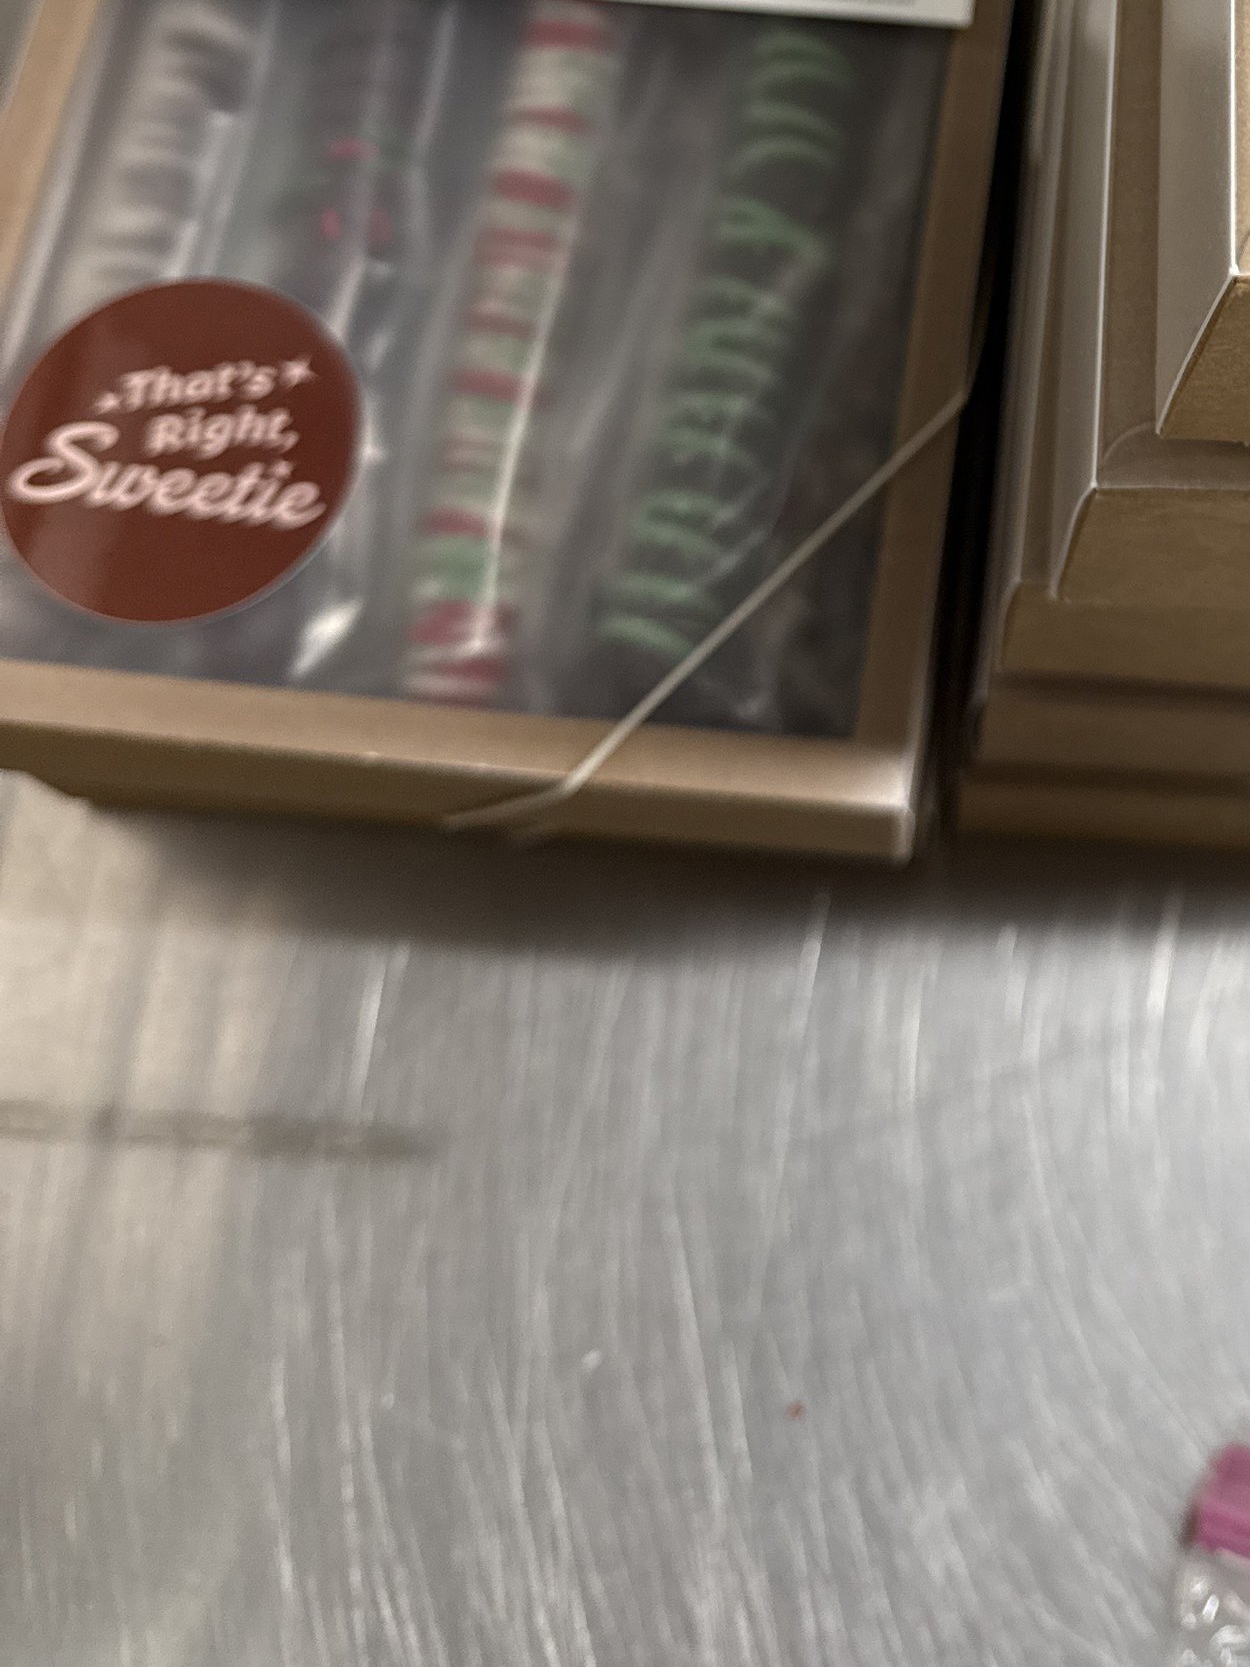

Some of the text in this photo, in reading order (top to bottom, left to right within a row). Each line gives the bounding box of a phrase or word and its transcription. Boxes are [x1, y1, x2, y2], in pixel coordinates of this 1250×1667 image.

[120, 359, 278, 412] That's
[146, 406, 299, 460] Right,
[9, 421, 328, 529] Sweetie
